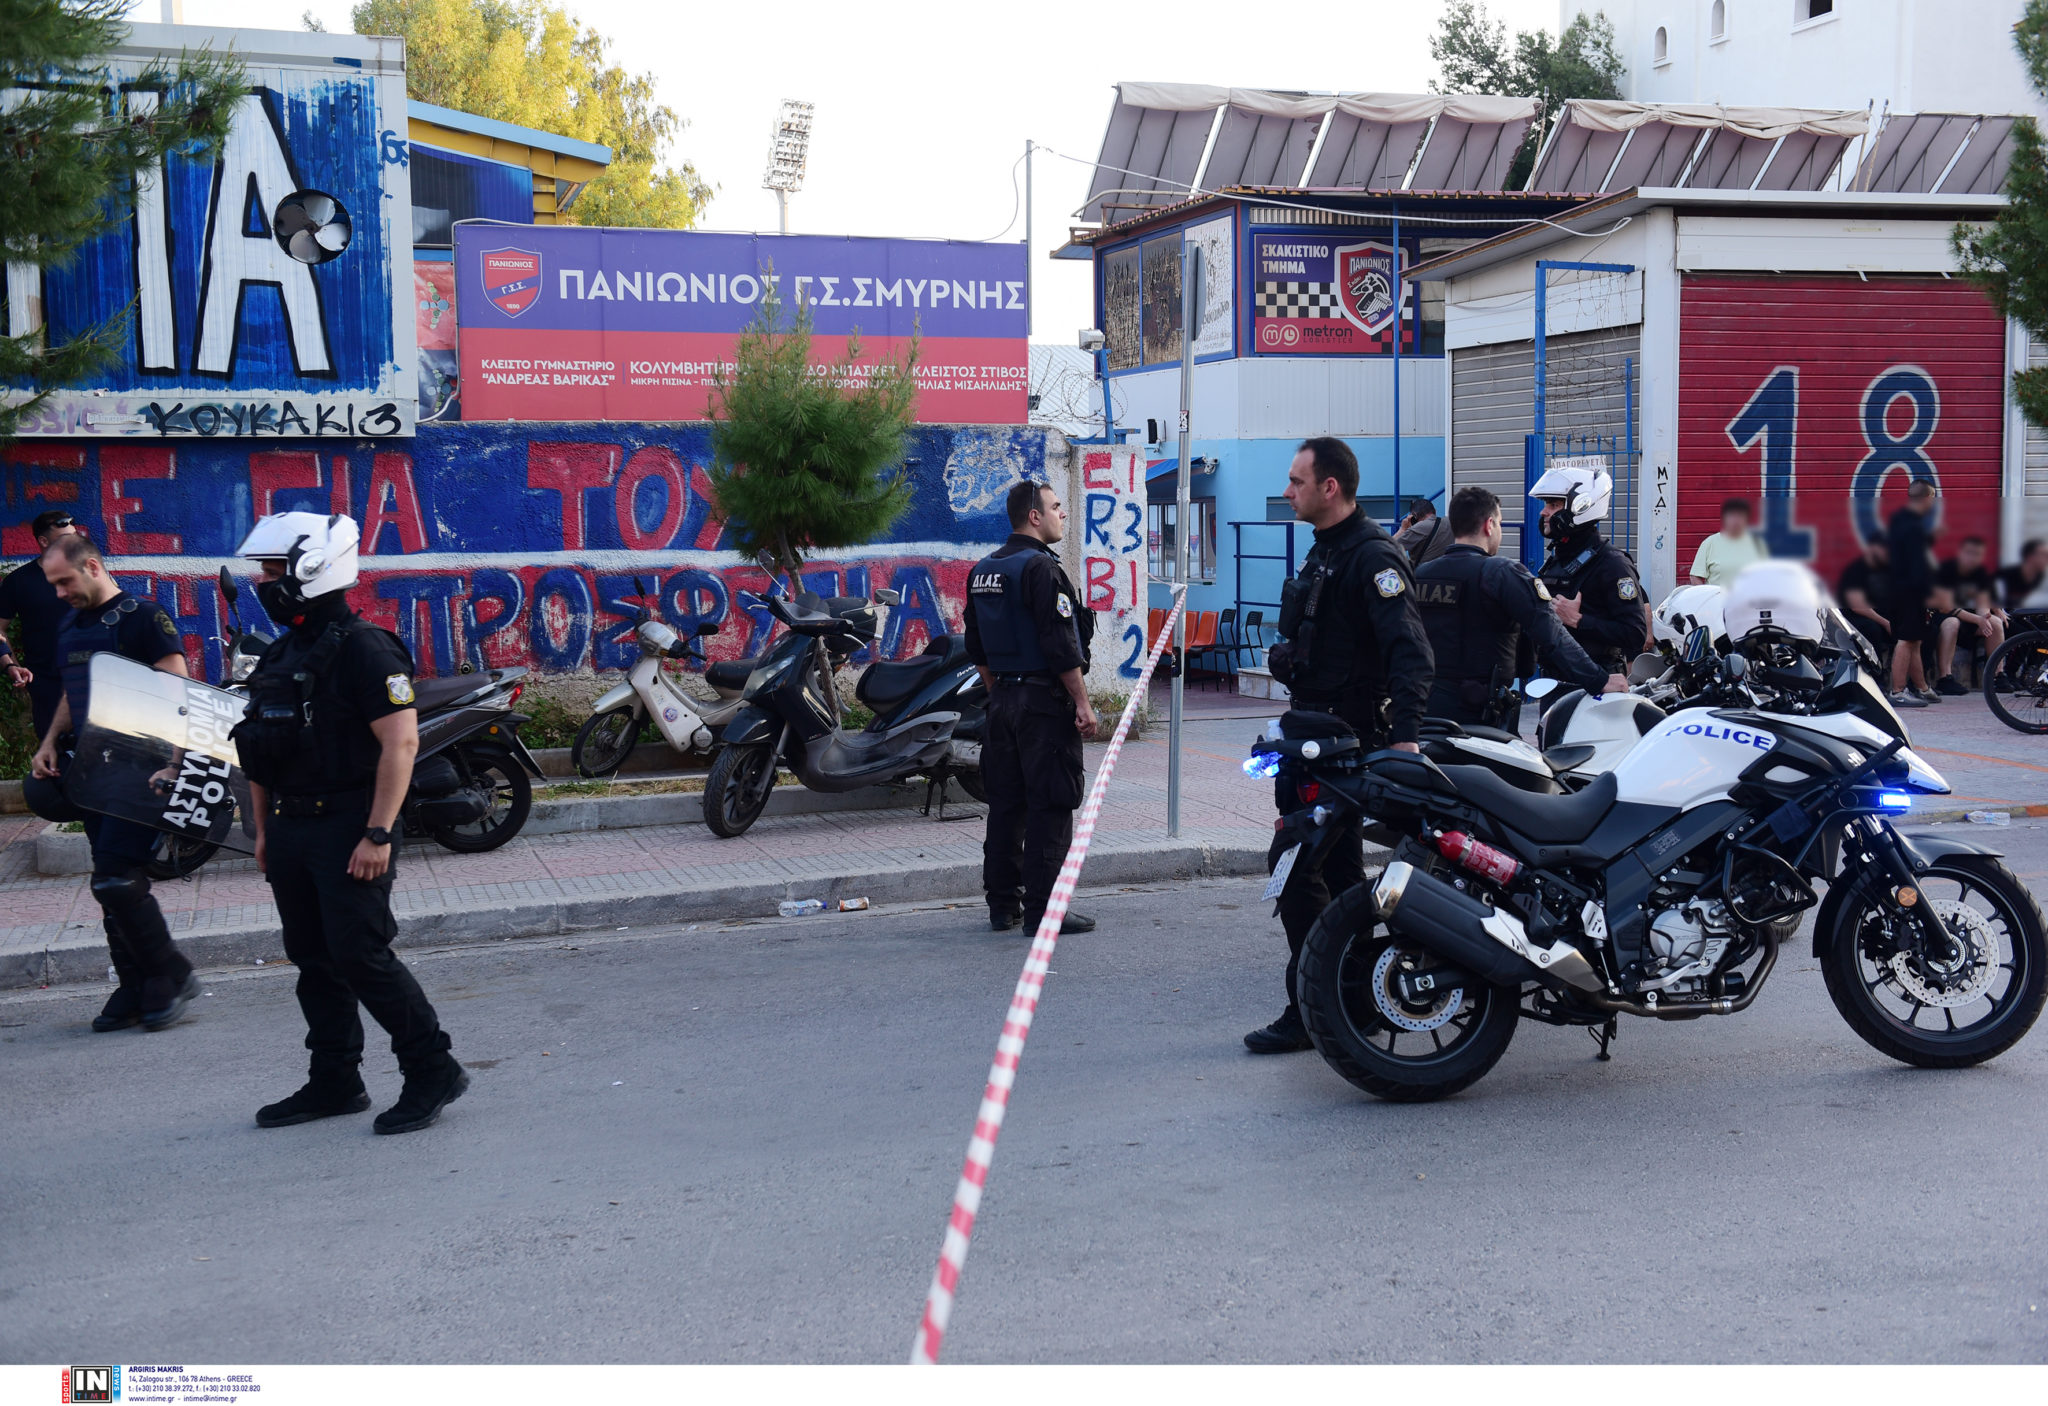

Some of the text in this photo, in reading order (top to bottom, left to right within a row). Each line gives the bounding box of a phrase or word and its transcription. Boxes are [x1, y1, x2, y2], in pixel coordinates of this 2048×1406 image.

[1262, 244, 1329, 259] ΣΚΑΚΙΣΤΙΚΟ
[489, 260, 534, 269] ΠΑΝΙΩΝΙΟΣ
[1262, 261, 1306, 274] ΤΜΗΜΑ
[1349, 257, 1392, 276] ΠΑΝΙΩΝΙΟΣ
[559, 269, 782, 304] ΠΑΝΙΩΝΙΟΣ
[1303, 324, 1353, 337] metron
[481, 359, 616, 372] ΚΛΕΙΣΤΟ ΓΥΜΝΑΣΤΗΡΙΟ
[912, 366, 1027, 379] ΚΛΕΙΣΤΟΣ ΣΤΙΒΟΣ
[482, 374, 616, 387] "ΑΝΔΡΕΑΣ ΒΑΡΙΚΑΣ"
[631, 378, 660, 386] ΜΙΚΡΗ
[663, 378, 692, 387] ΠΙΣΙΝΑ
[162, 687, 215, 829] ΑΣΤΥΝΟΜΙΑ
[189, 697, 235, 829] POLICE
